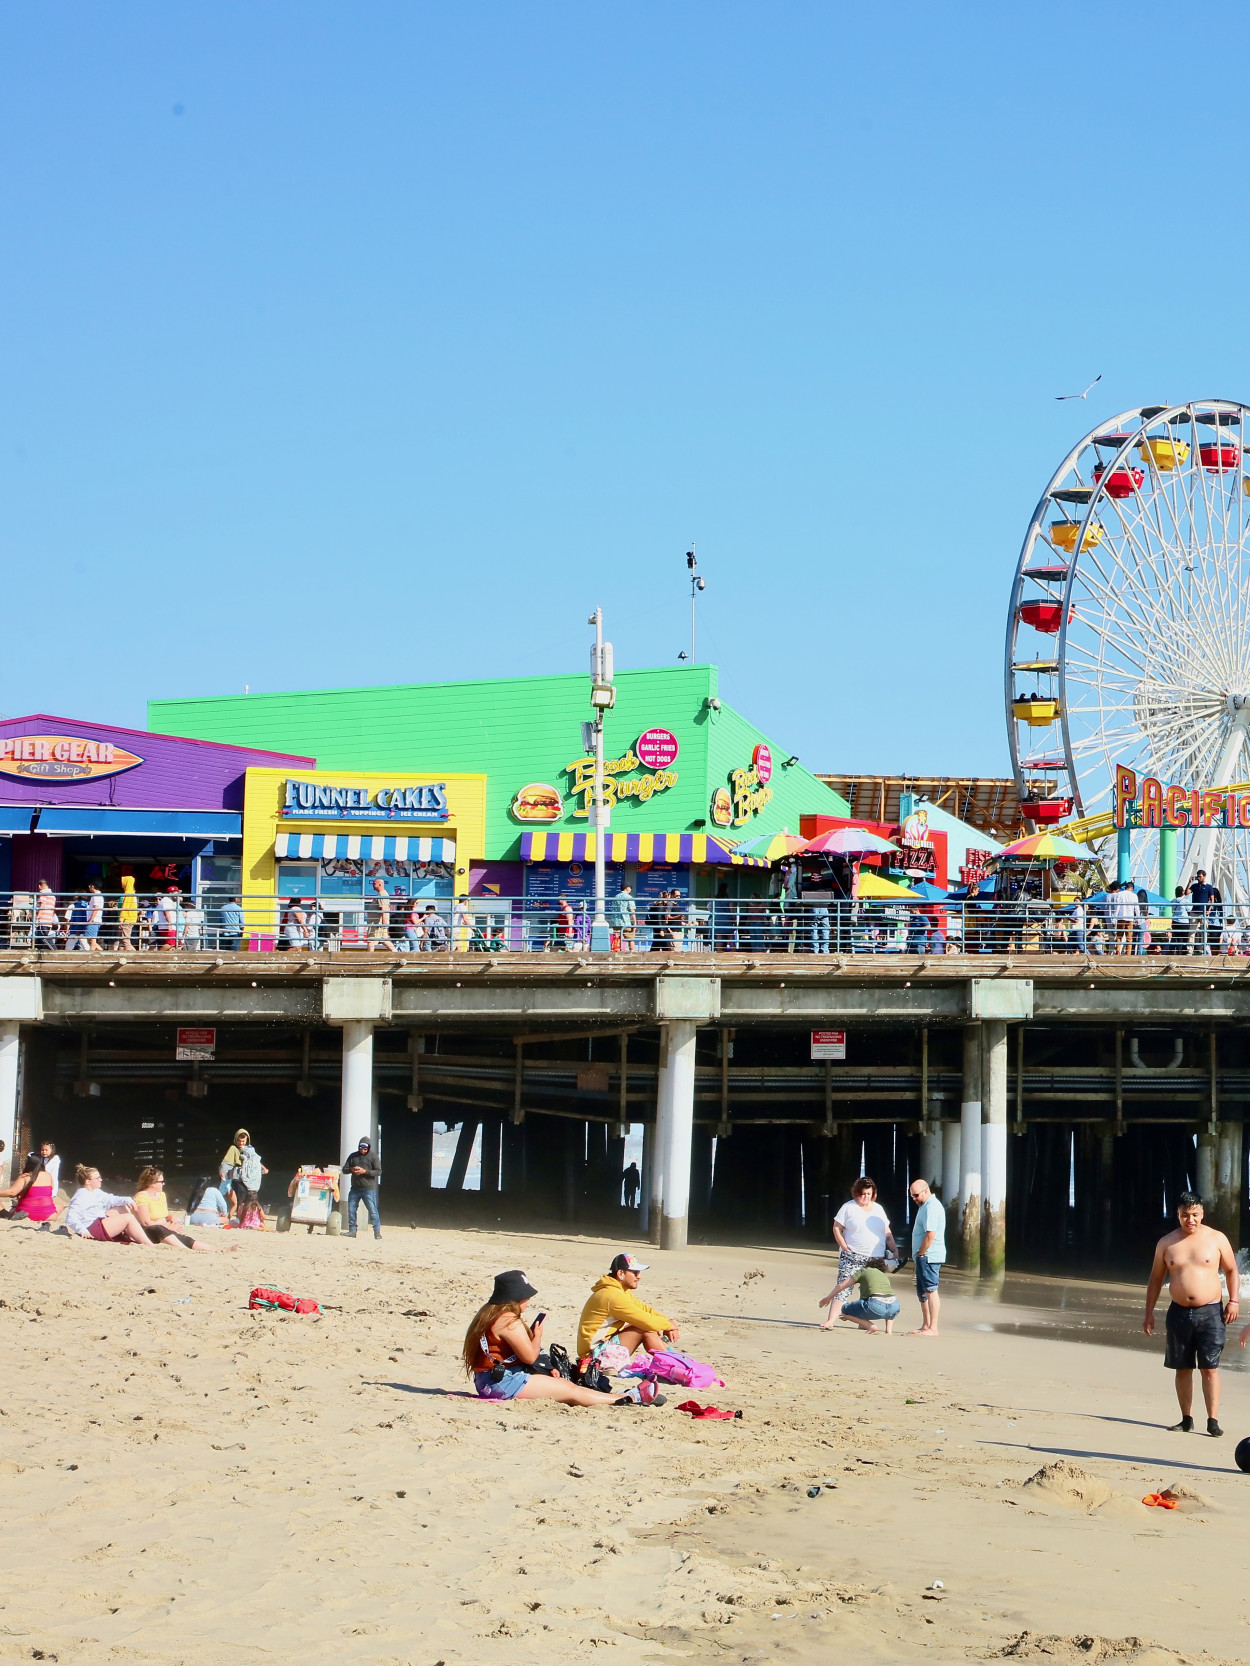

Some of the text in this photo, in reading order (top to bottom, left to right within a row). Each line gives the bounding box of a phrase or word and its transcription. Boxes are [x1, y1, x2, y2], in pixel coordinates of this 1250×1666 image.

[0, 740, 115, 764] PIER GEAR
[660, 744, 676, 752] FRIES
[656, 755, 671, 763] DOGS
[29, 764, 80, 776] Gift Shop
[284, 779, 448, 810] FUNNEL CAKES
[894, 848, 940, 870] PIZZA
